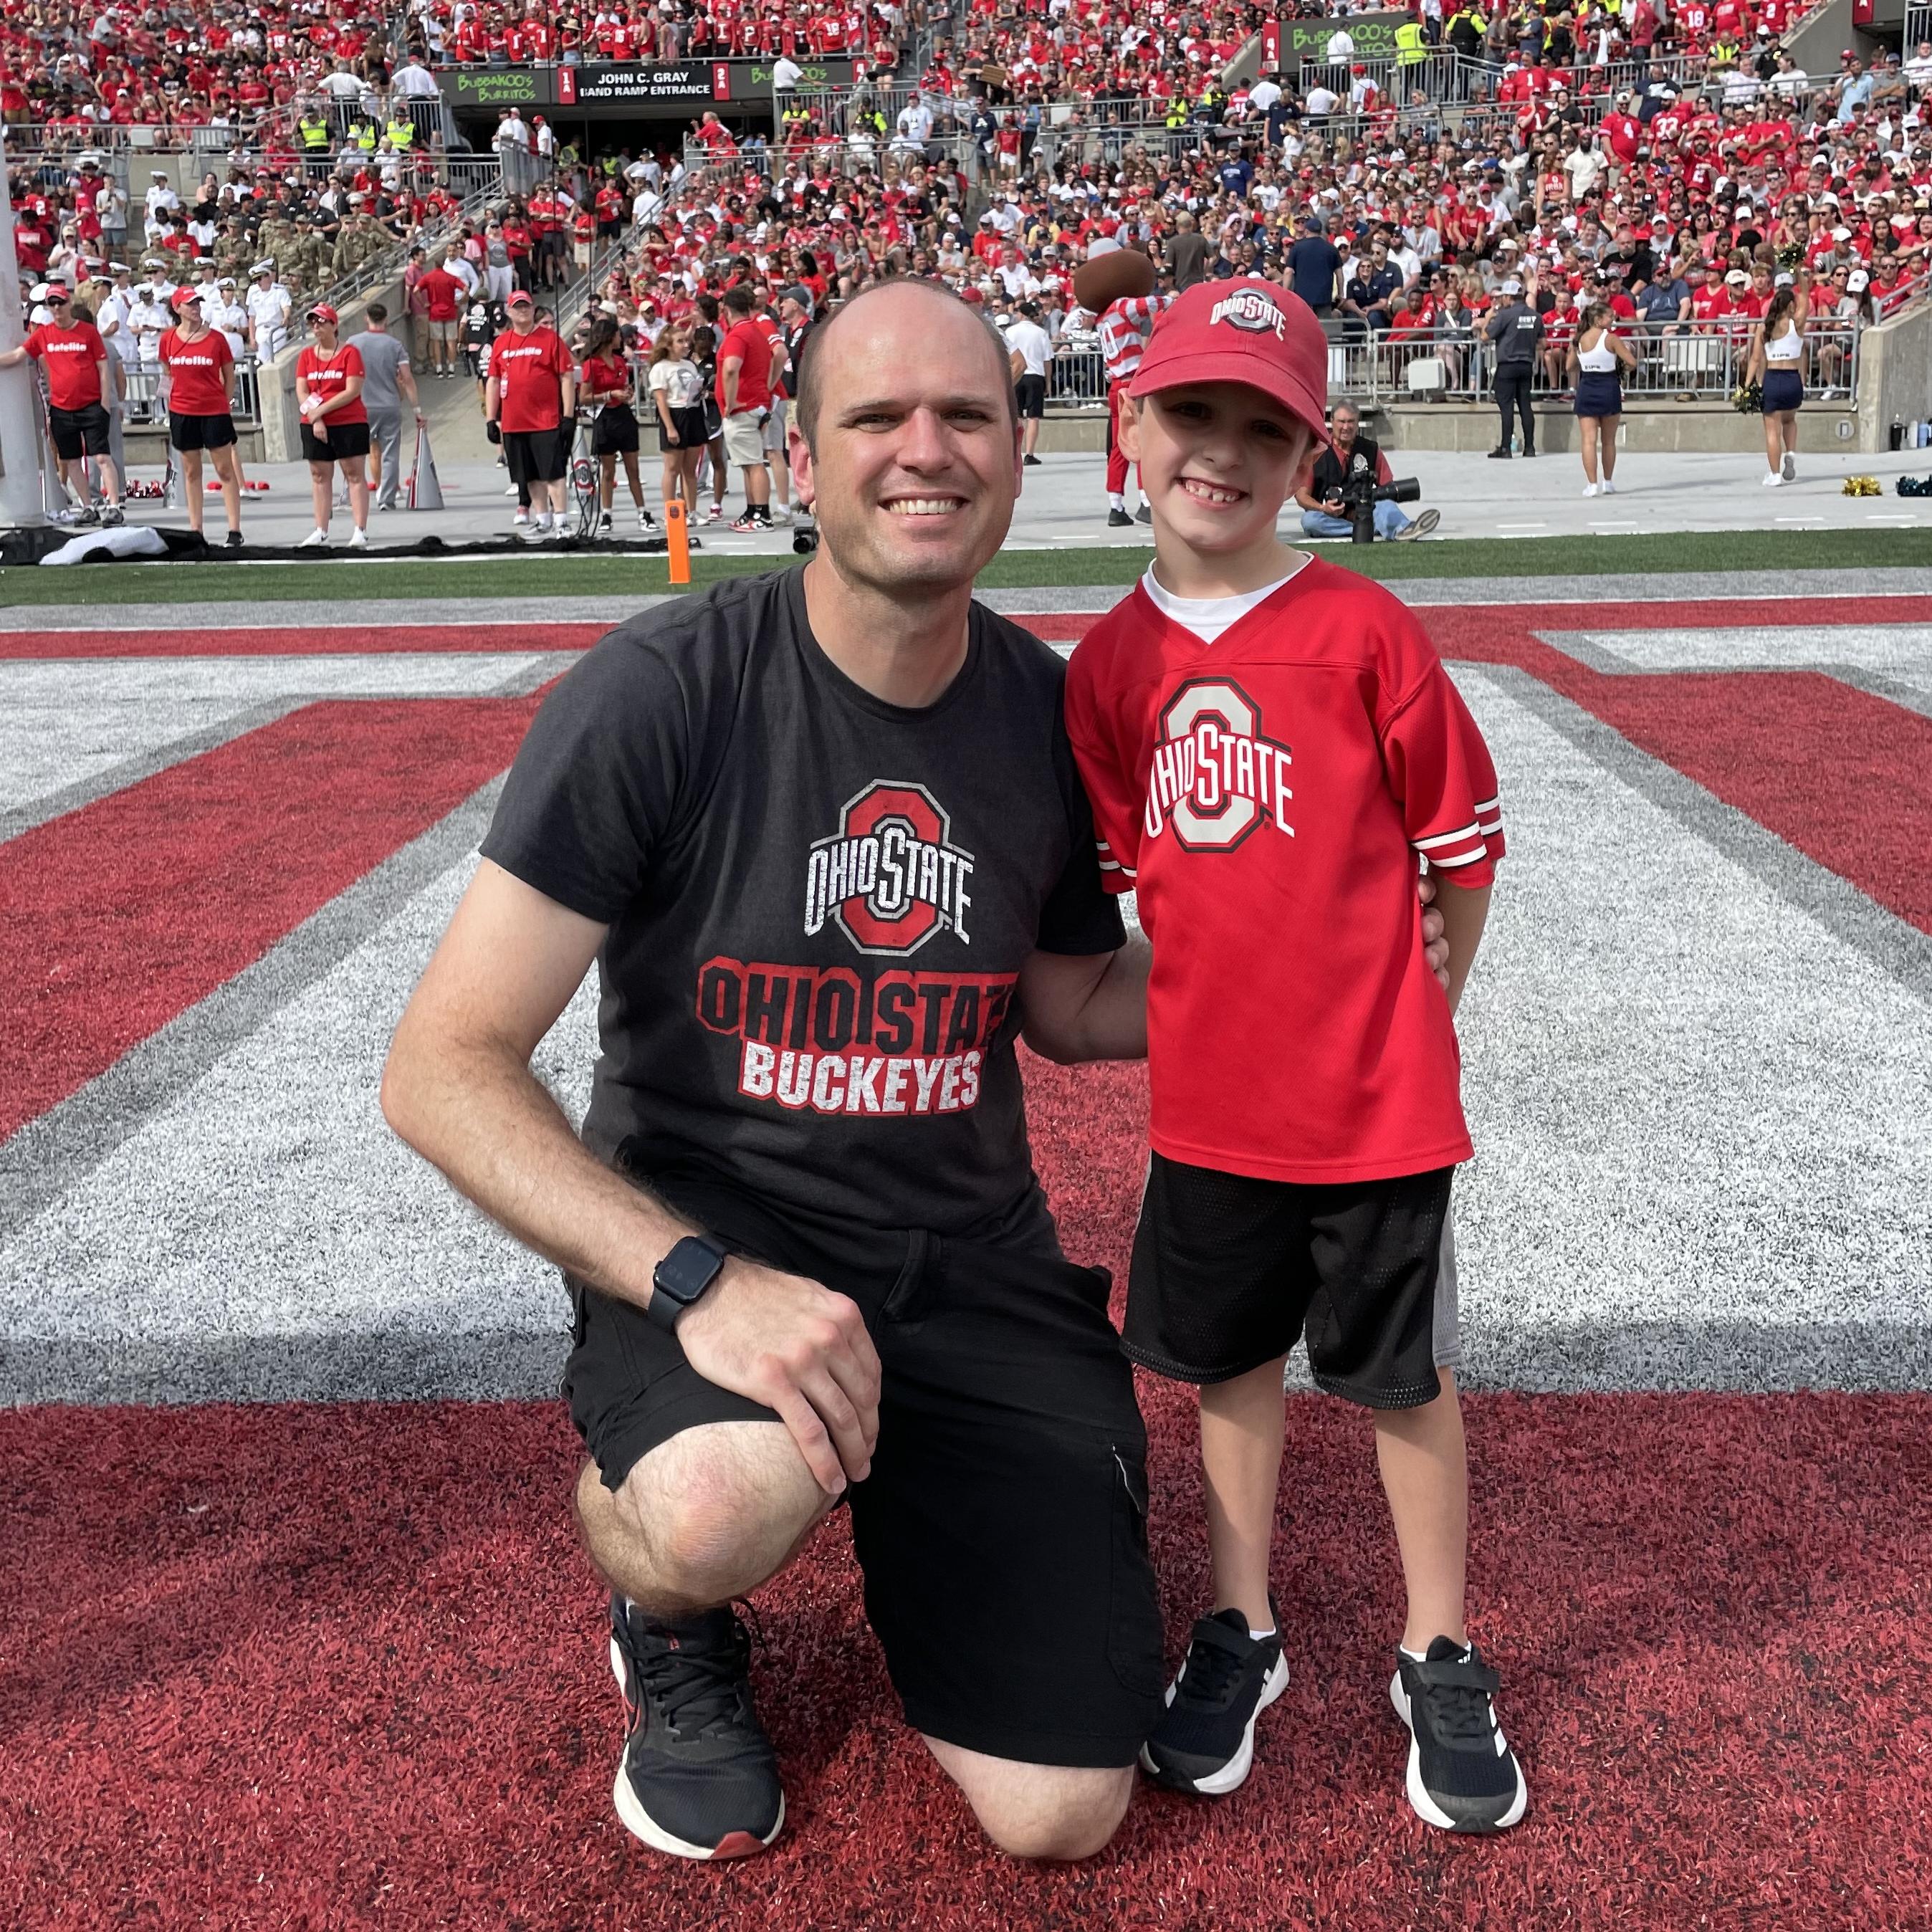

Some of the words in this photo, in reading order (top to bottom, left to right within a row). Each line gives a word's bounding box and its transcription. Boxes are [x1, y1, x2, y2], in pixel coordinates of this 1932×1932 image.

[563, 72, 570, 84] 1
[598, 73, 633, 85] JOHN
[636, 72, 650, 84] C.
[653, 72, 689, 83] GRAY
[717, 68, 725, 80] 2
[580, 87, 612, 97] BAND
[614, 86, 648, 96] RAMP
[650, 85, 710, 95] ENTRANCE
[1624, 122, 1634, 139] 4
[36, 200, 46, 216] 2
[1210, 297, 1247, 325] OHIO
[1244, 296, 1286, 342] STATE
[1145, 735, 1195, 838] OHIO
[1197, 724, 1295, 838] STATE
[804, 837, 879, 937] OHIO
[878, 827, 974, 945] STATE
[697, 956, 861, 1052] OHIO
[742, 1041, 981, 1112] BUCKEYES
